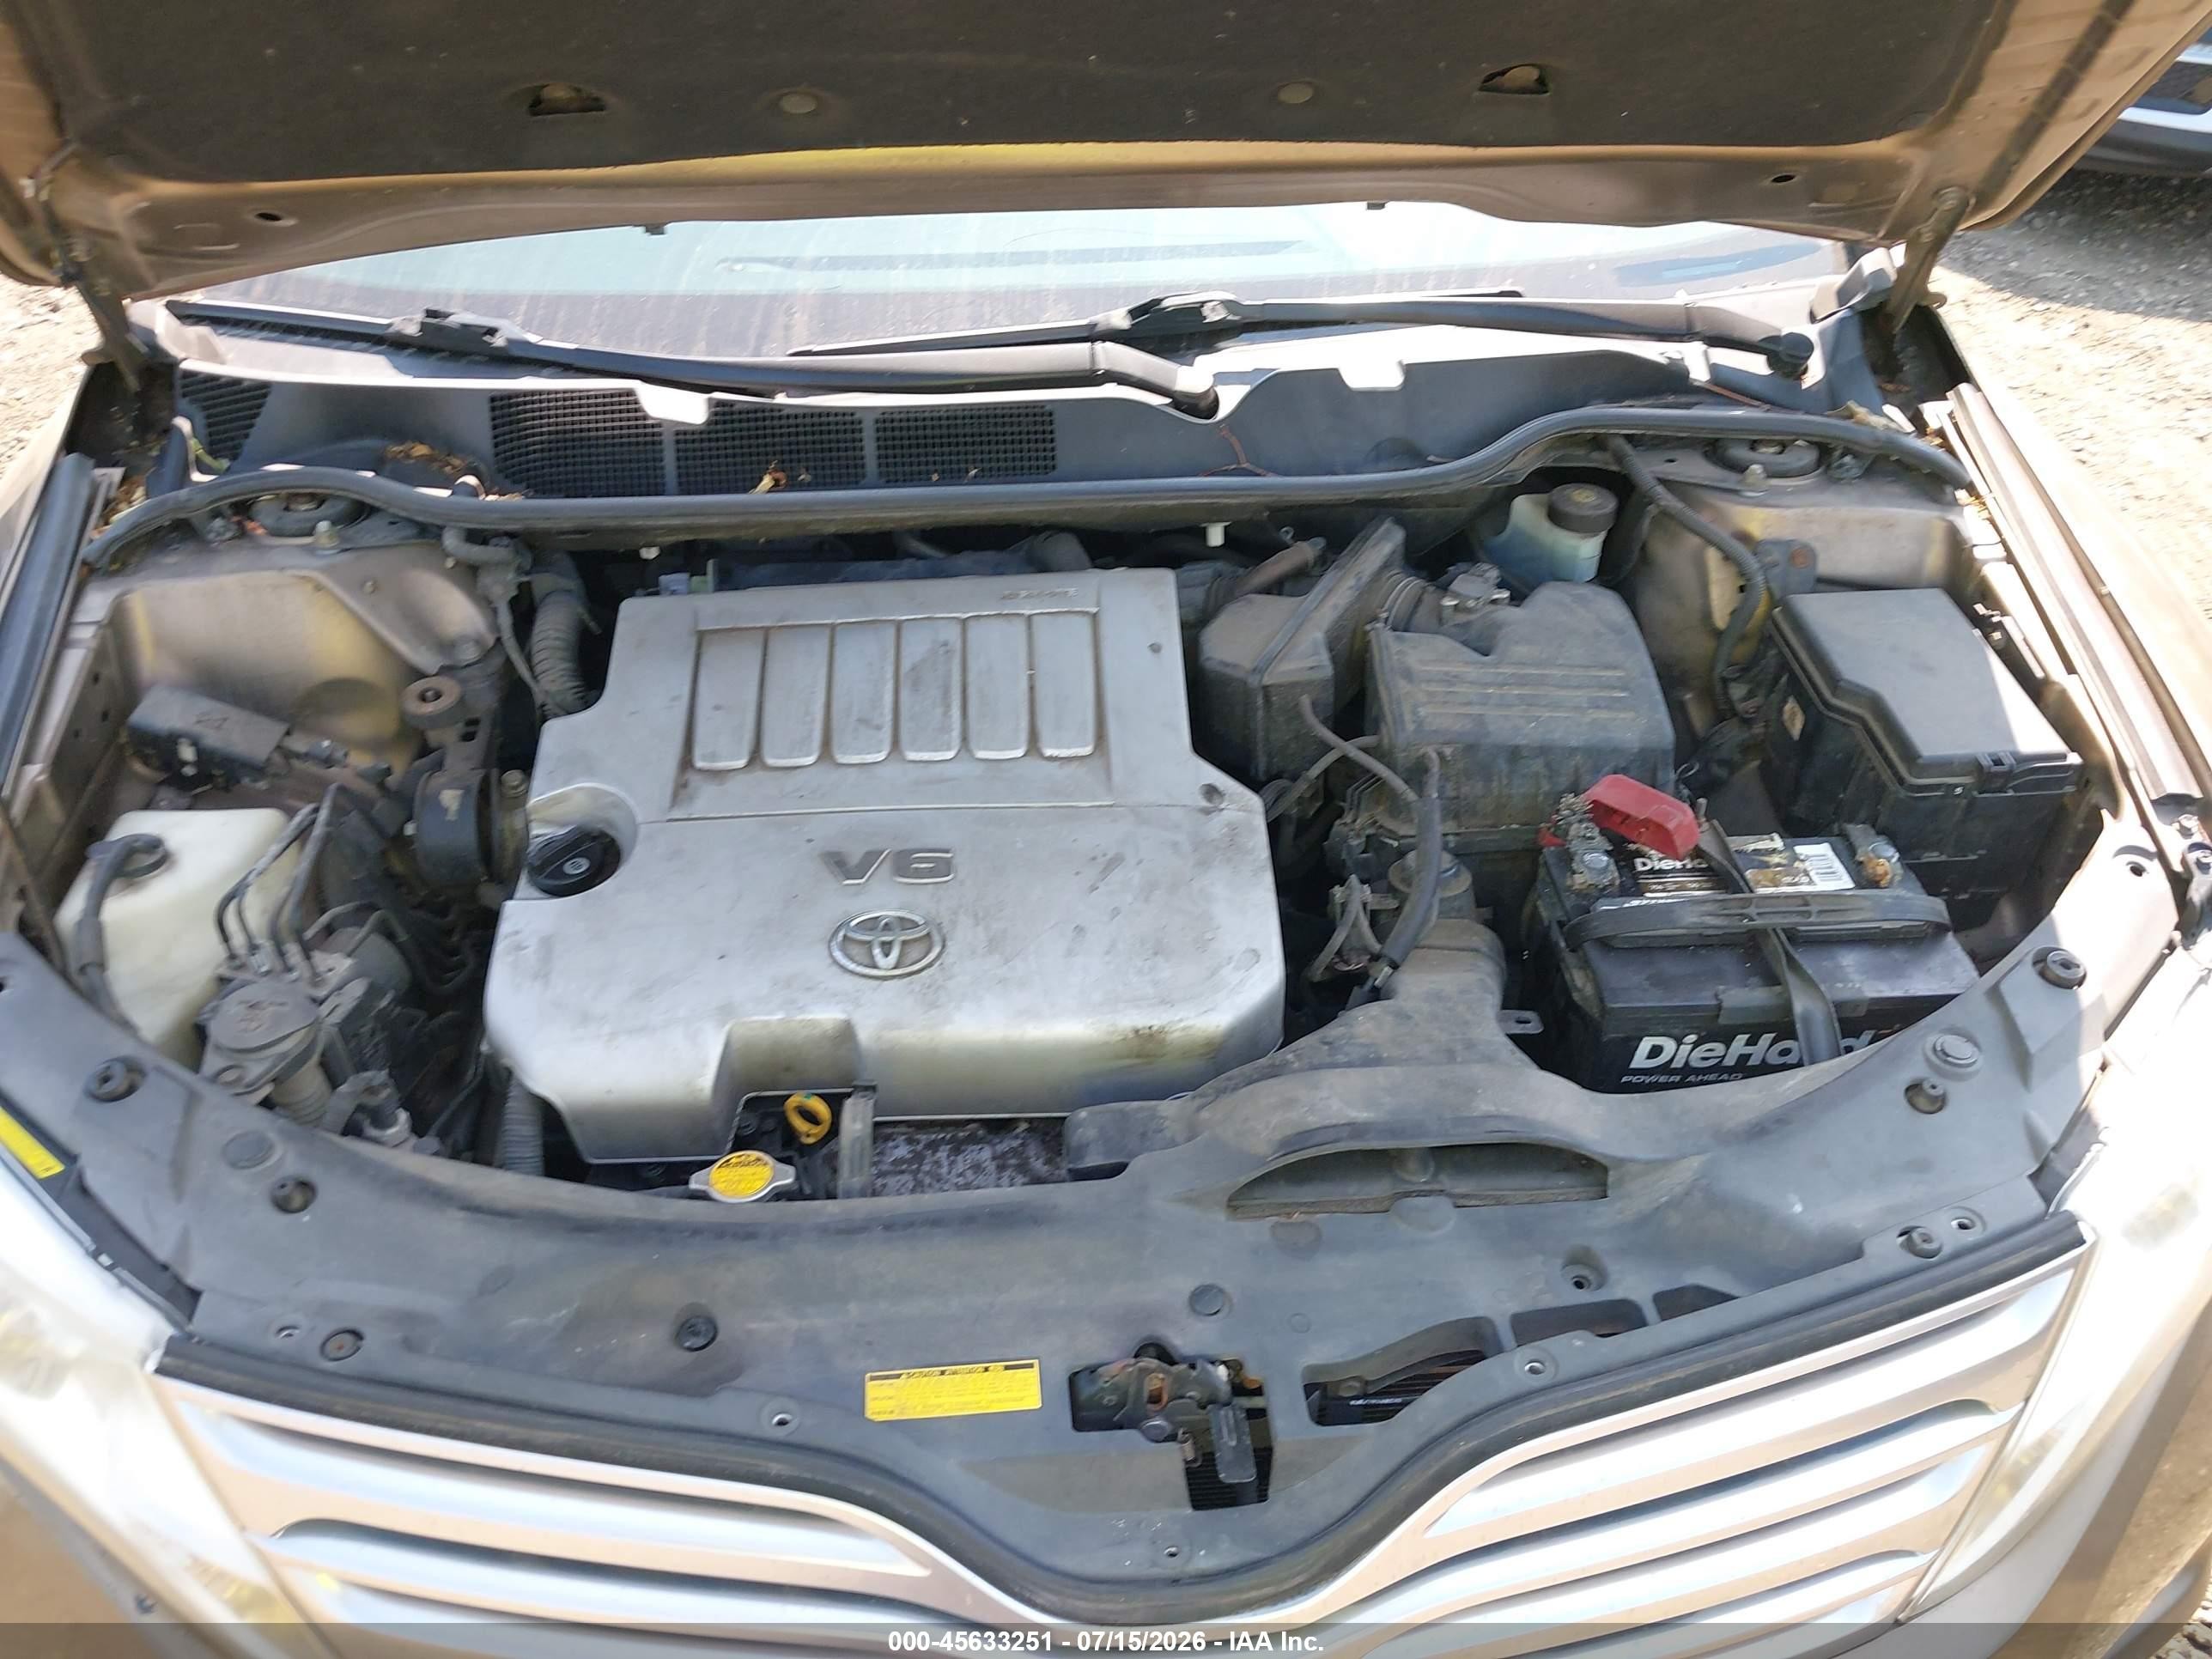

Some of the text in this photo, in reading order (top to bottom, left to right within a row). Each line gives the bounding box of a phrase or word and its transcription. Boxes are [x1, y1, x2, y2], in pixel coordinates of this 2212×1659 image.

[819, 848, 955, 884] V6
[1633, 857, 1709, 872] DieHa
[1628, 1030, 1876, 1069] DieHad
[1620, 1073, 1744, 1085] POWER AHEAD
